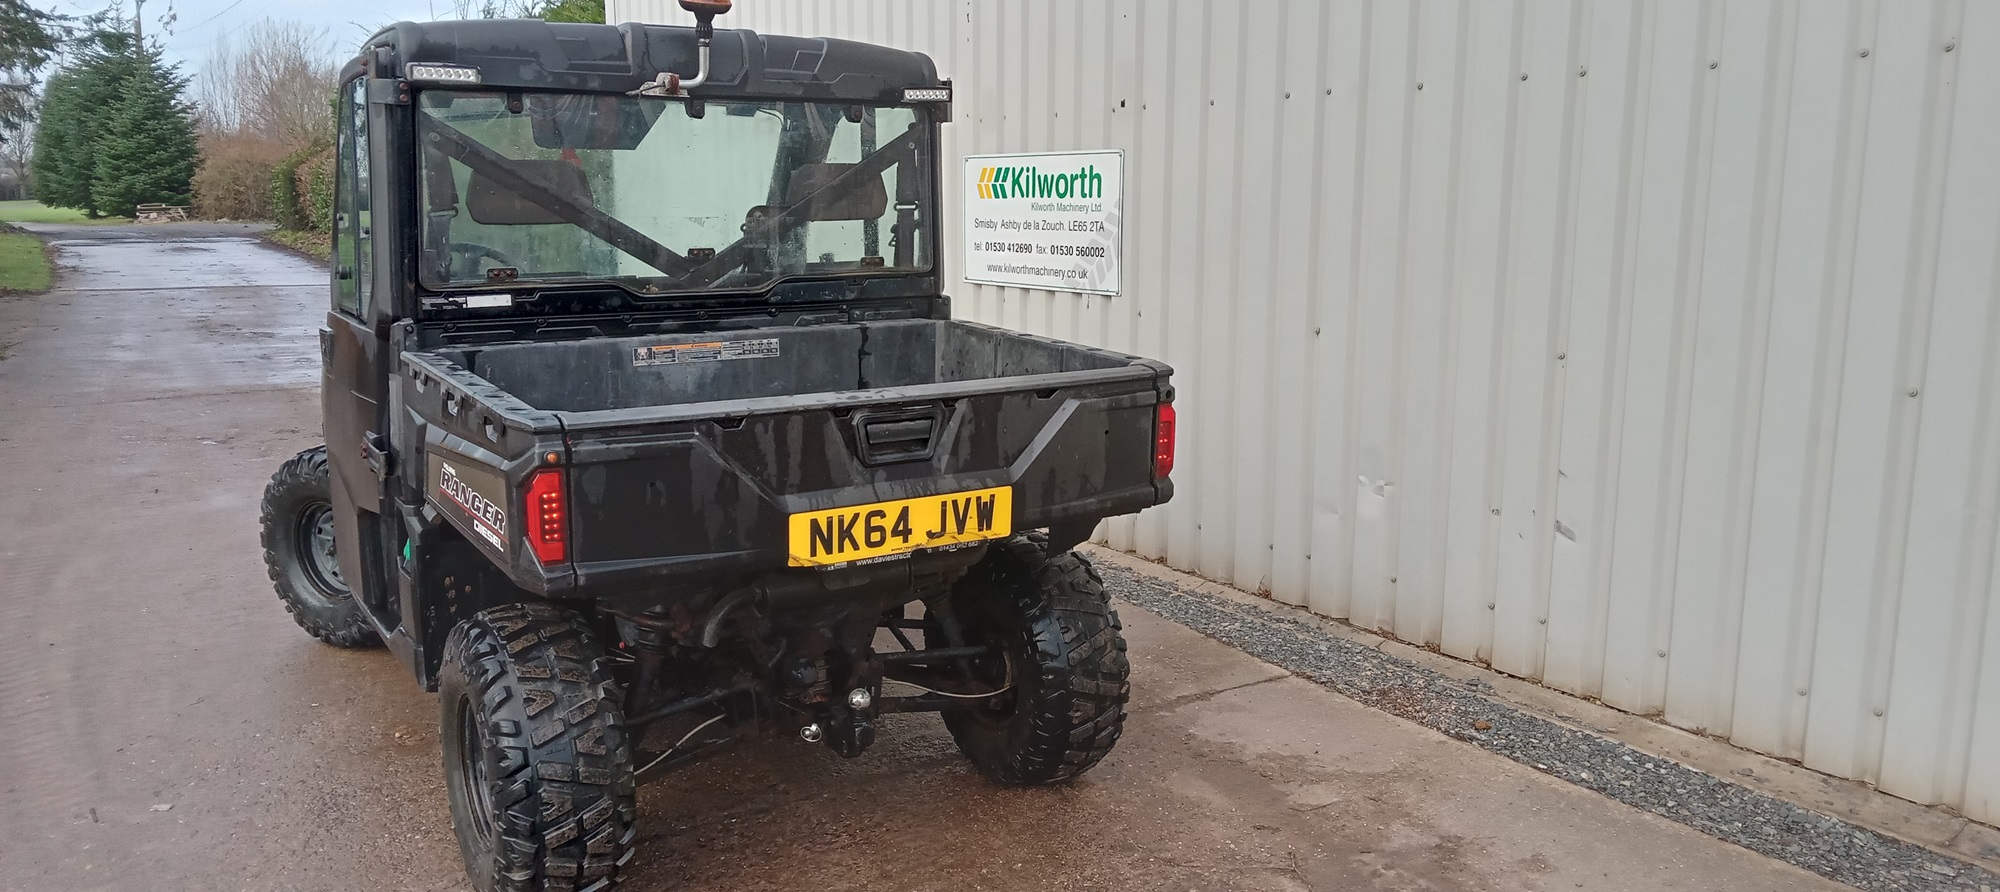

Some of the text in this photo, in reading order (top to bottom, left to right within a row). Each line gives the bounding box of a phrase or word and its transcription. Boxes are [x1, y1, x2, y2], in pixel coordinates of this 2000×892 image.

[1011, 164, 1102, 199] Kilworth
[1031, 202, 1104, 214] Kilworth Machinery Ltd.
[974, 218, 998, 231] Smisby
[1000, 219, 1022, 232] Ashby
[1023, 220, 1032, 230] de
[1033, 220, 1040, 231] la
[1068, 220, 1088, 232] LE65
[1089, 221, 1105, 232] 2TA
[974, 241, 1105, 258] tel: 01530 412690 fax: 01530 560002
[987, 263, 1088, 280] www.kilworthmachinery.couk
[440, 468, 506, 535] RANGER
[473, 519, 504, 553] DIESEL
[809, 494, 996, 558] NK64 JVW
